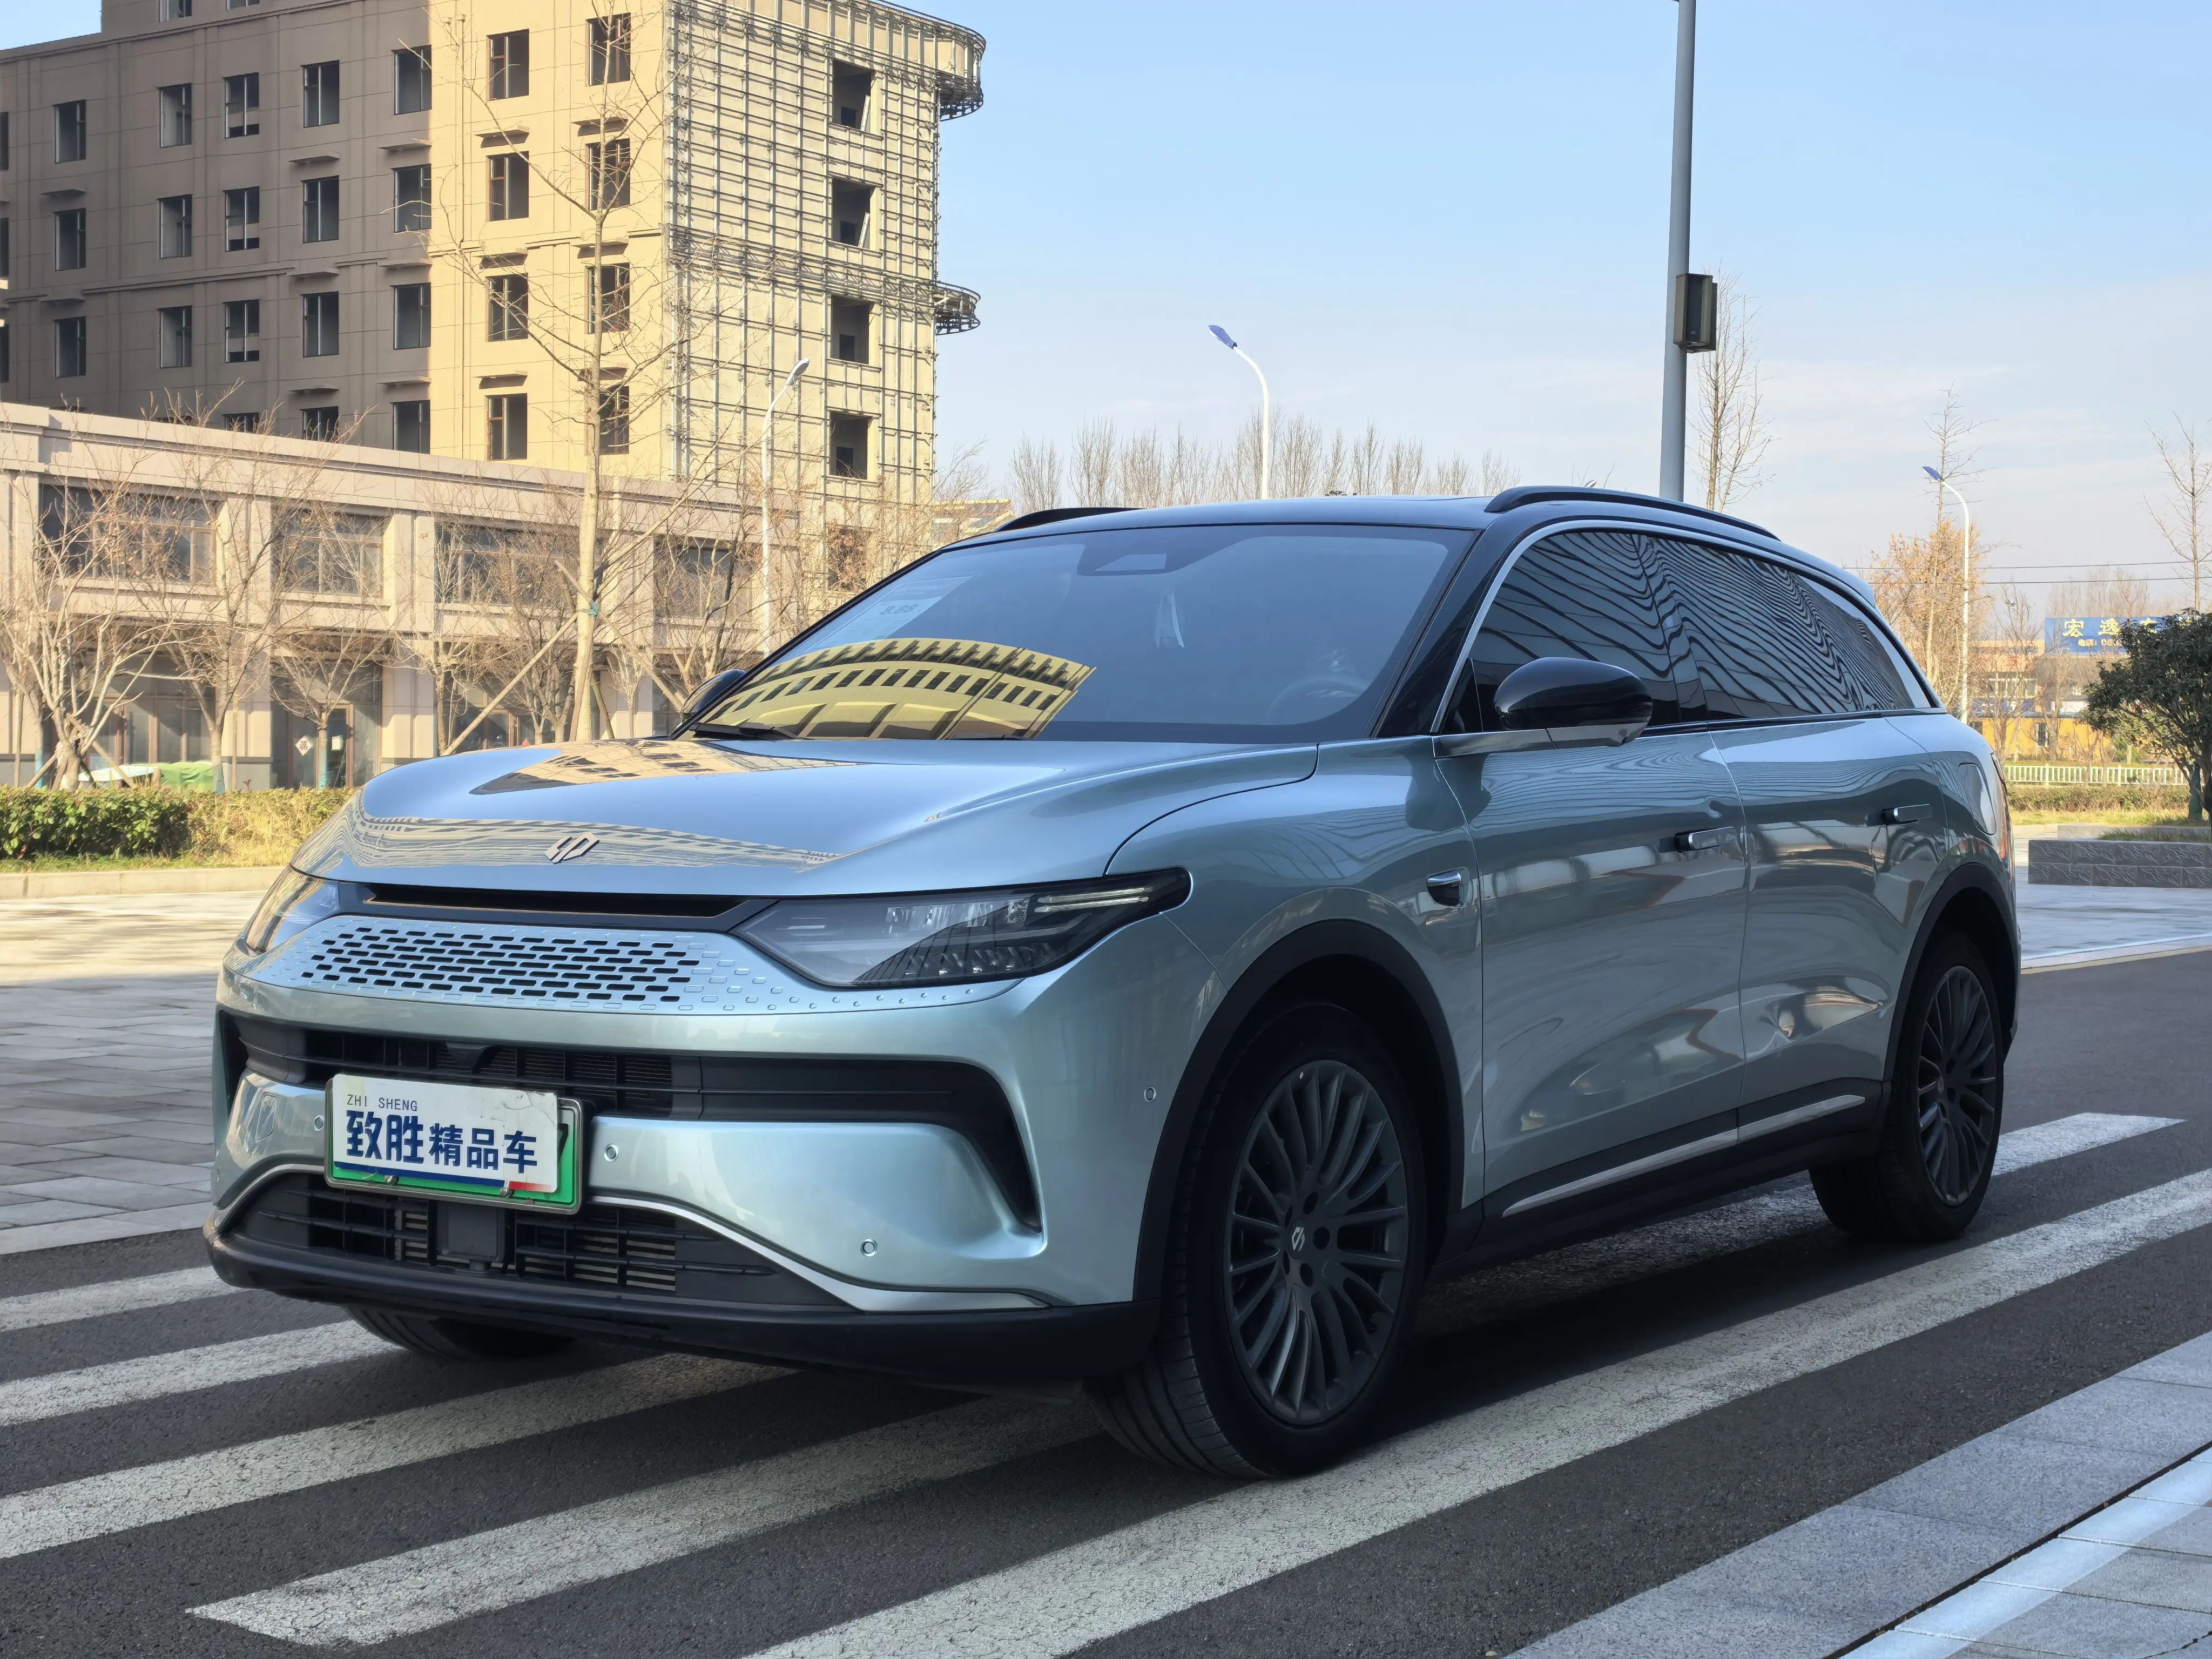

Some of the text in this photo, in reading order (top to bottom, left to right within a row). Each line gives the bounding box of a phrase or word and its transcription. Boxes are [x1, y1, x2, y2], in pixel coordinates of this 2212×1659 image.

[347, 1094, 417, 1112] ZHI SHENG
[346, 1109, 538, 1174] 致胜精品车
